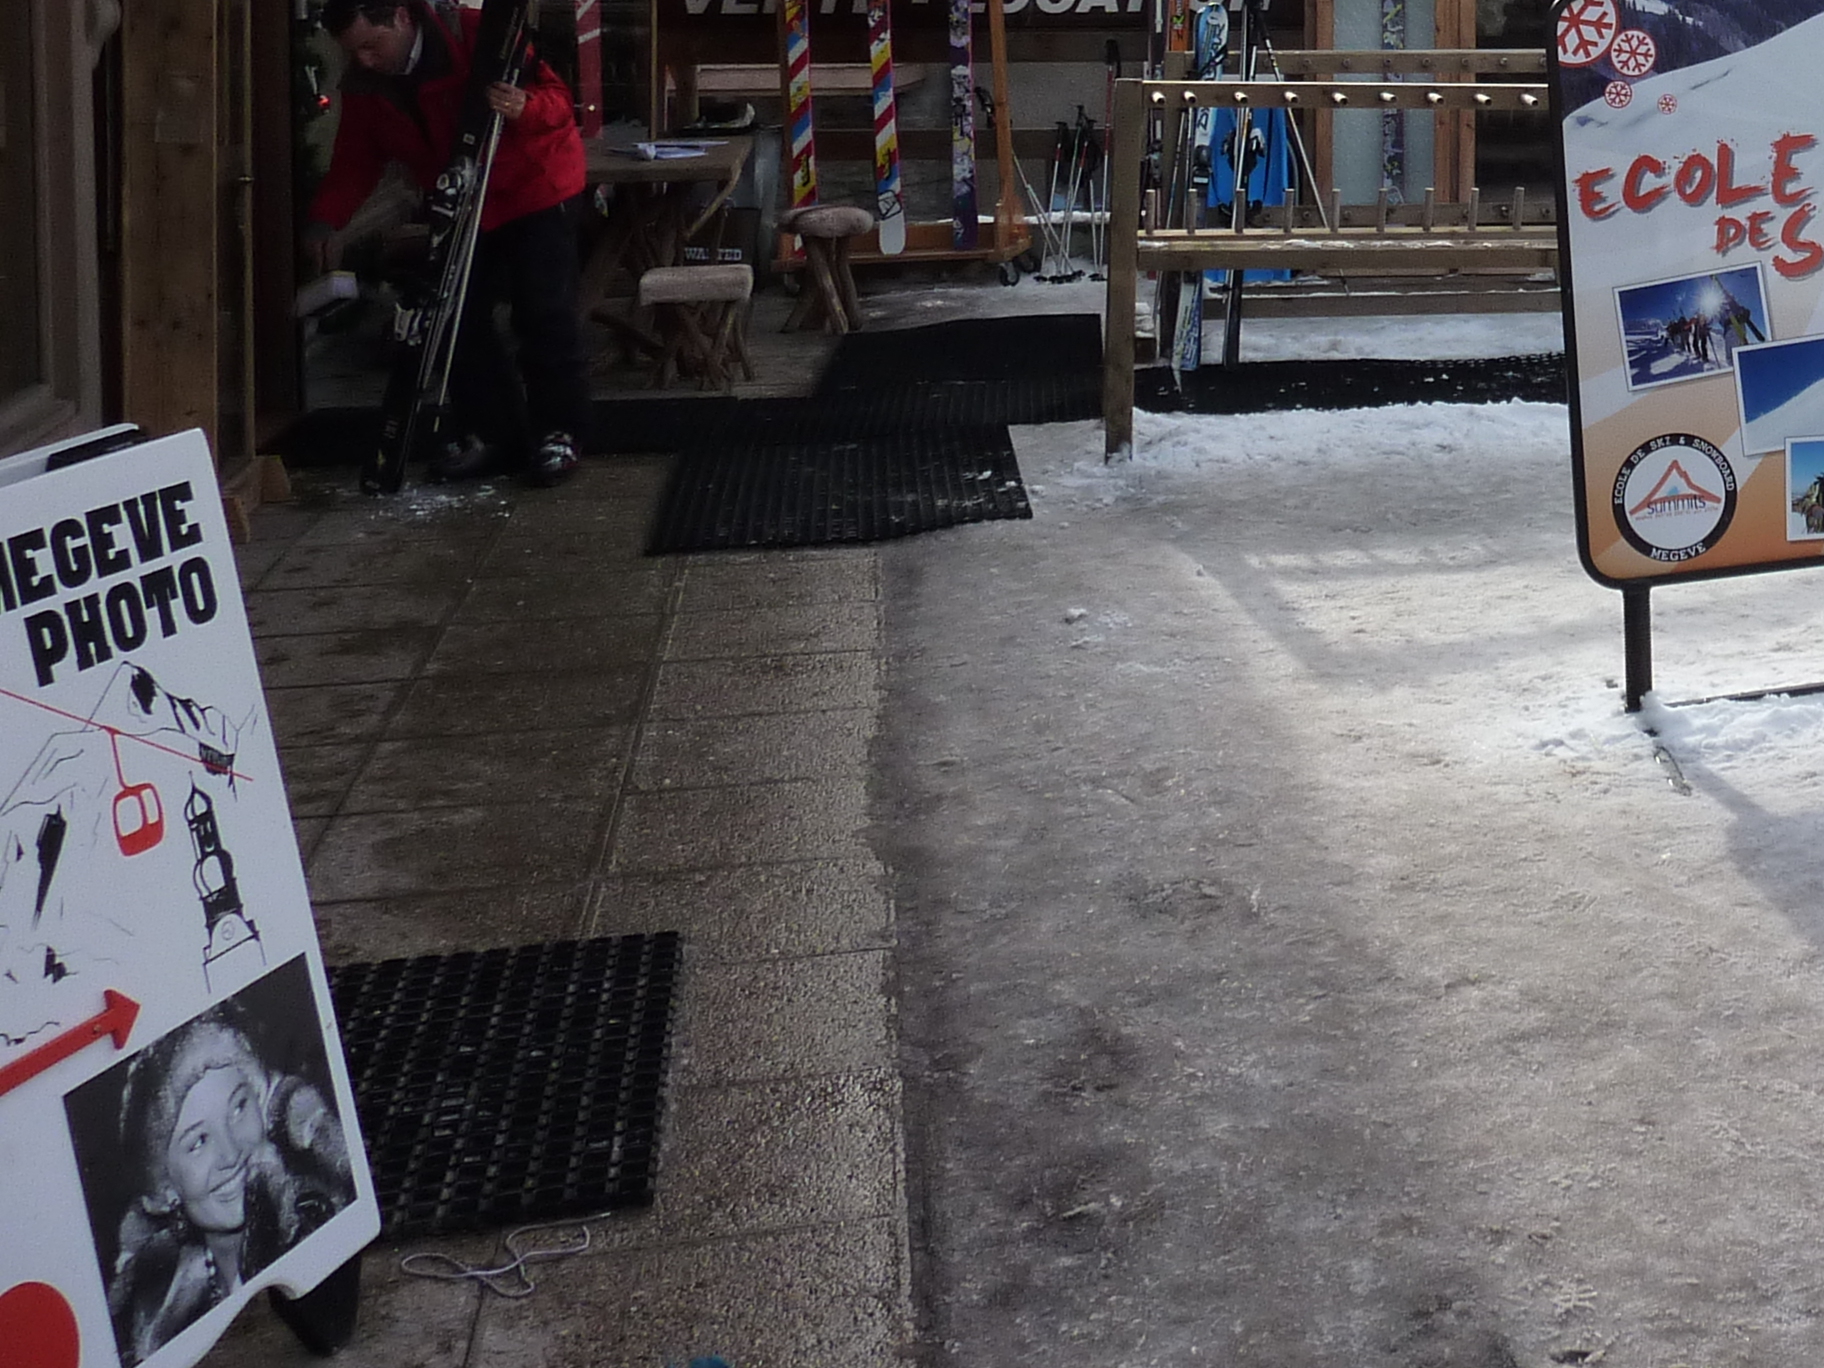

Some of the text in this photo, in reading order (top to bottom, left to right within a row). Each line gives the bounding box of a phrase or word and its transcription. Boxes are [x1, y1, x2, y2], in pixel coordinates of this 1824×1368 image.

[1572, 132, 1818, 219] ECOLE
[684, 247, 742, 261] WATED
[1713, 211, 1775, 254] DE
[1614, 467, 1631, 504] ECOLE
[1630, 450, 1645, 464] DE
[1650, 436, 1670, 450] SKI
[1692, 438, 1734, 491] SNOWBOARD
[1650, 542, 1706, 561] MEGEVE
[24, 556, 218, 687] PHOTO
